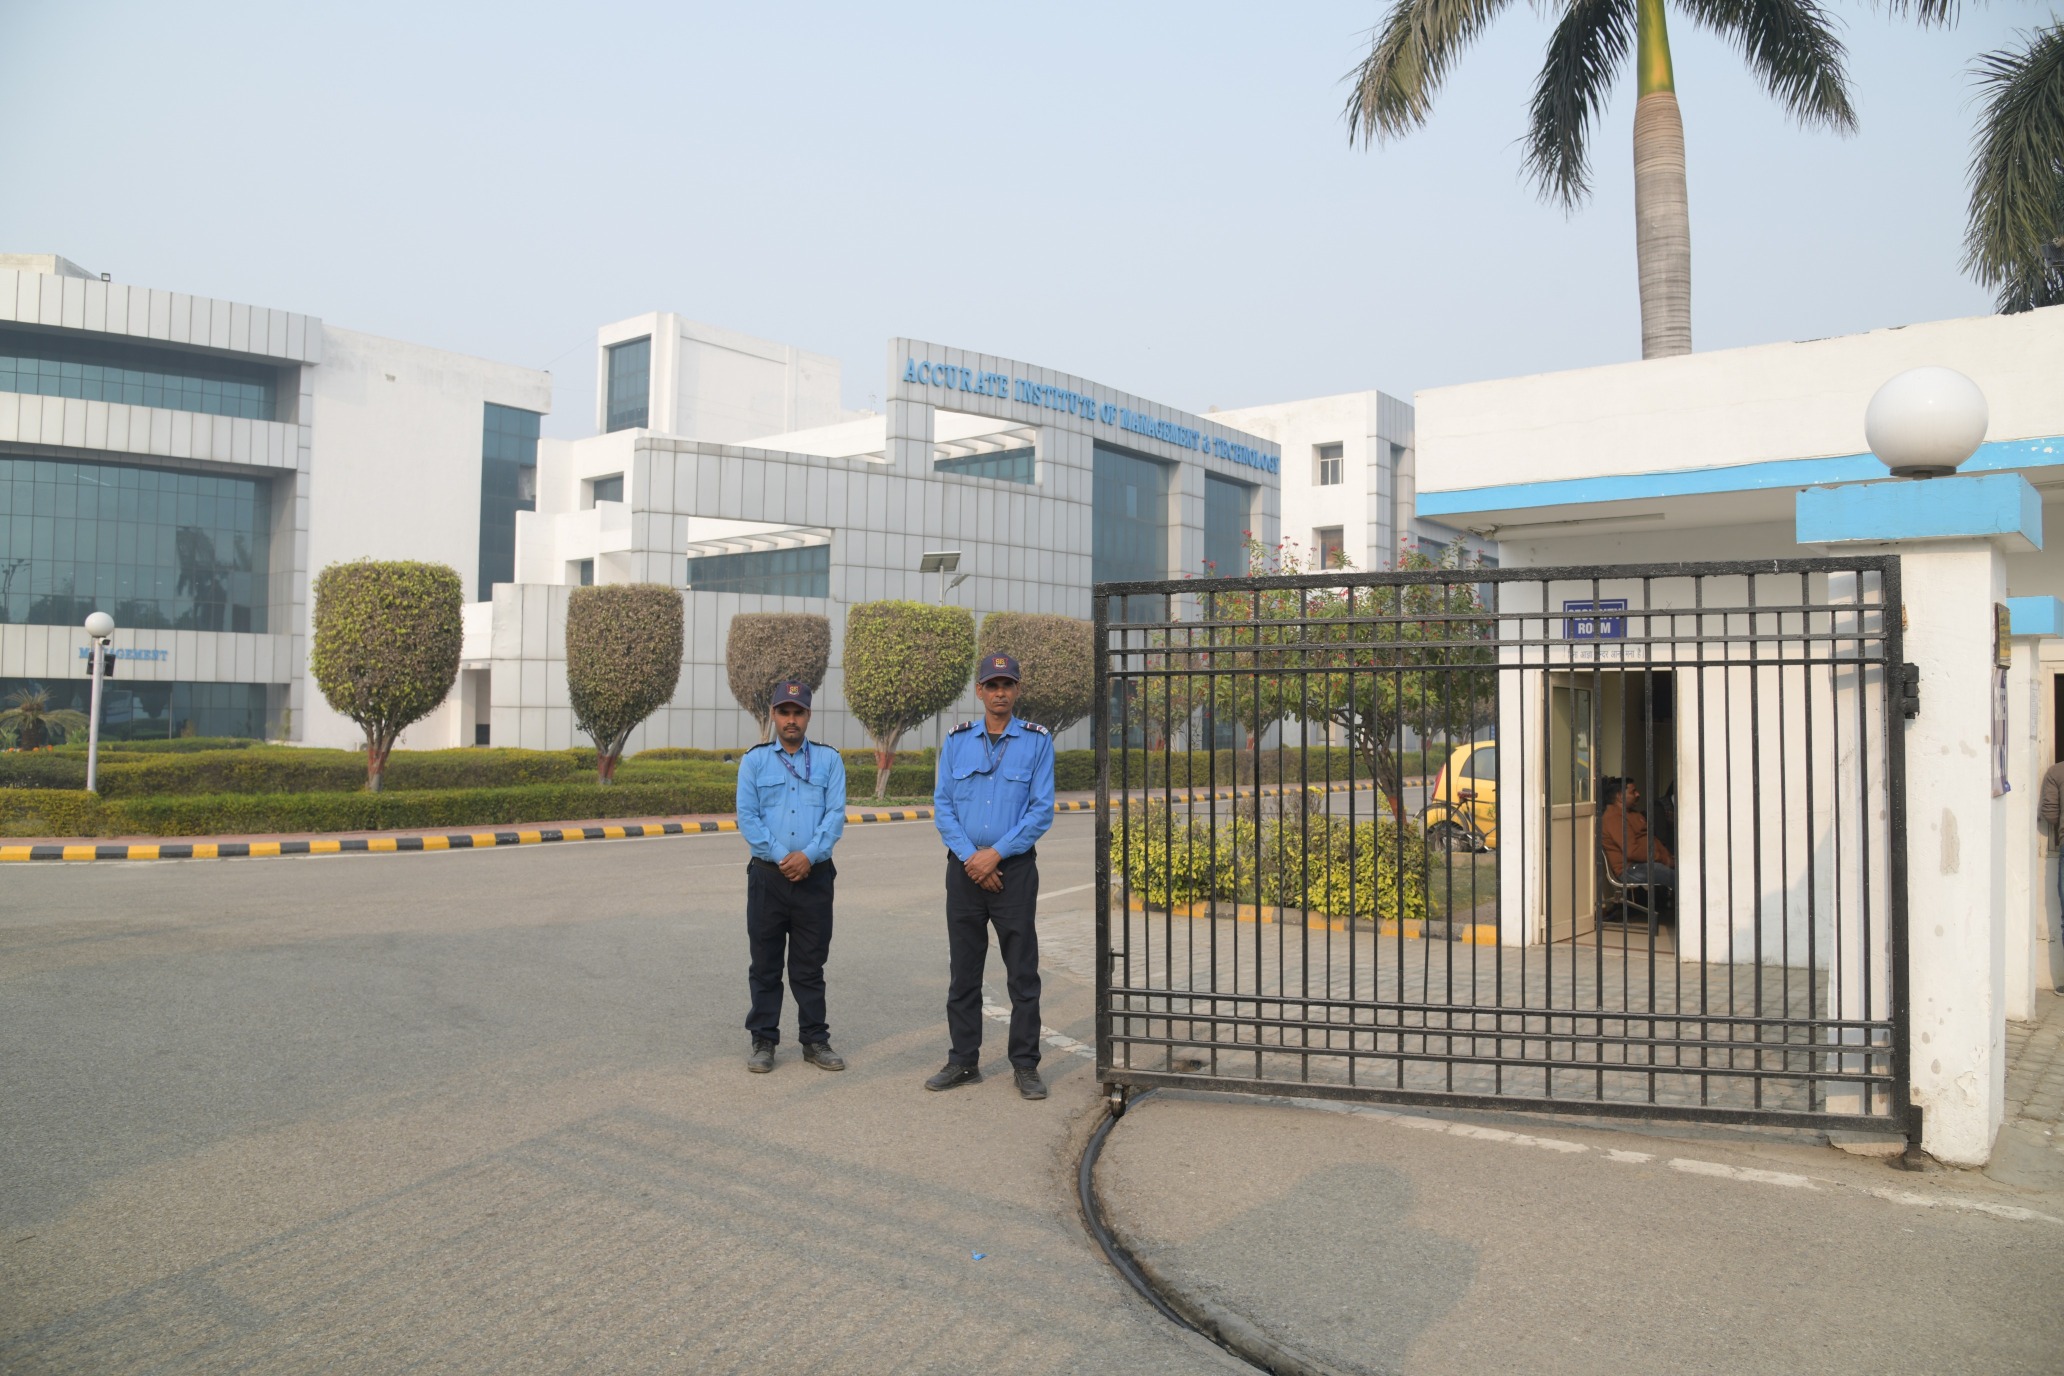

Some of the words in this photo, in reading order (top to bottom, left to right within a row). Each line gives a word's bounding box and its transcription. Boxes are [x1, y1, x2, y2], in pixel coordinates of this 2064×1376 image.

[903, 357, 1009, 399] ACCURATE
[1014, 378, 1096, 421] INSTITUTE
[1100, 400, 1117, 426] OF
[1120, 407, 1201, 451] MANAGEMENT
[1202, 434, 1210, 455] &
[1213, 436, 1280, 475] TECHNOLOGY
[1577, 622, 1611, 635] ROM
[79, 647, 168, 661] MAGEMENT
